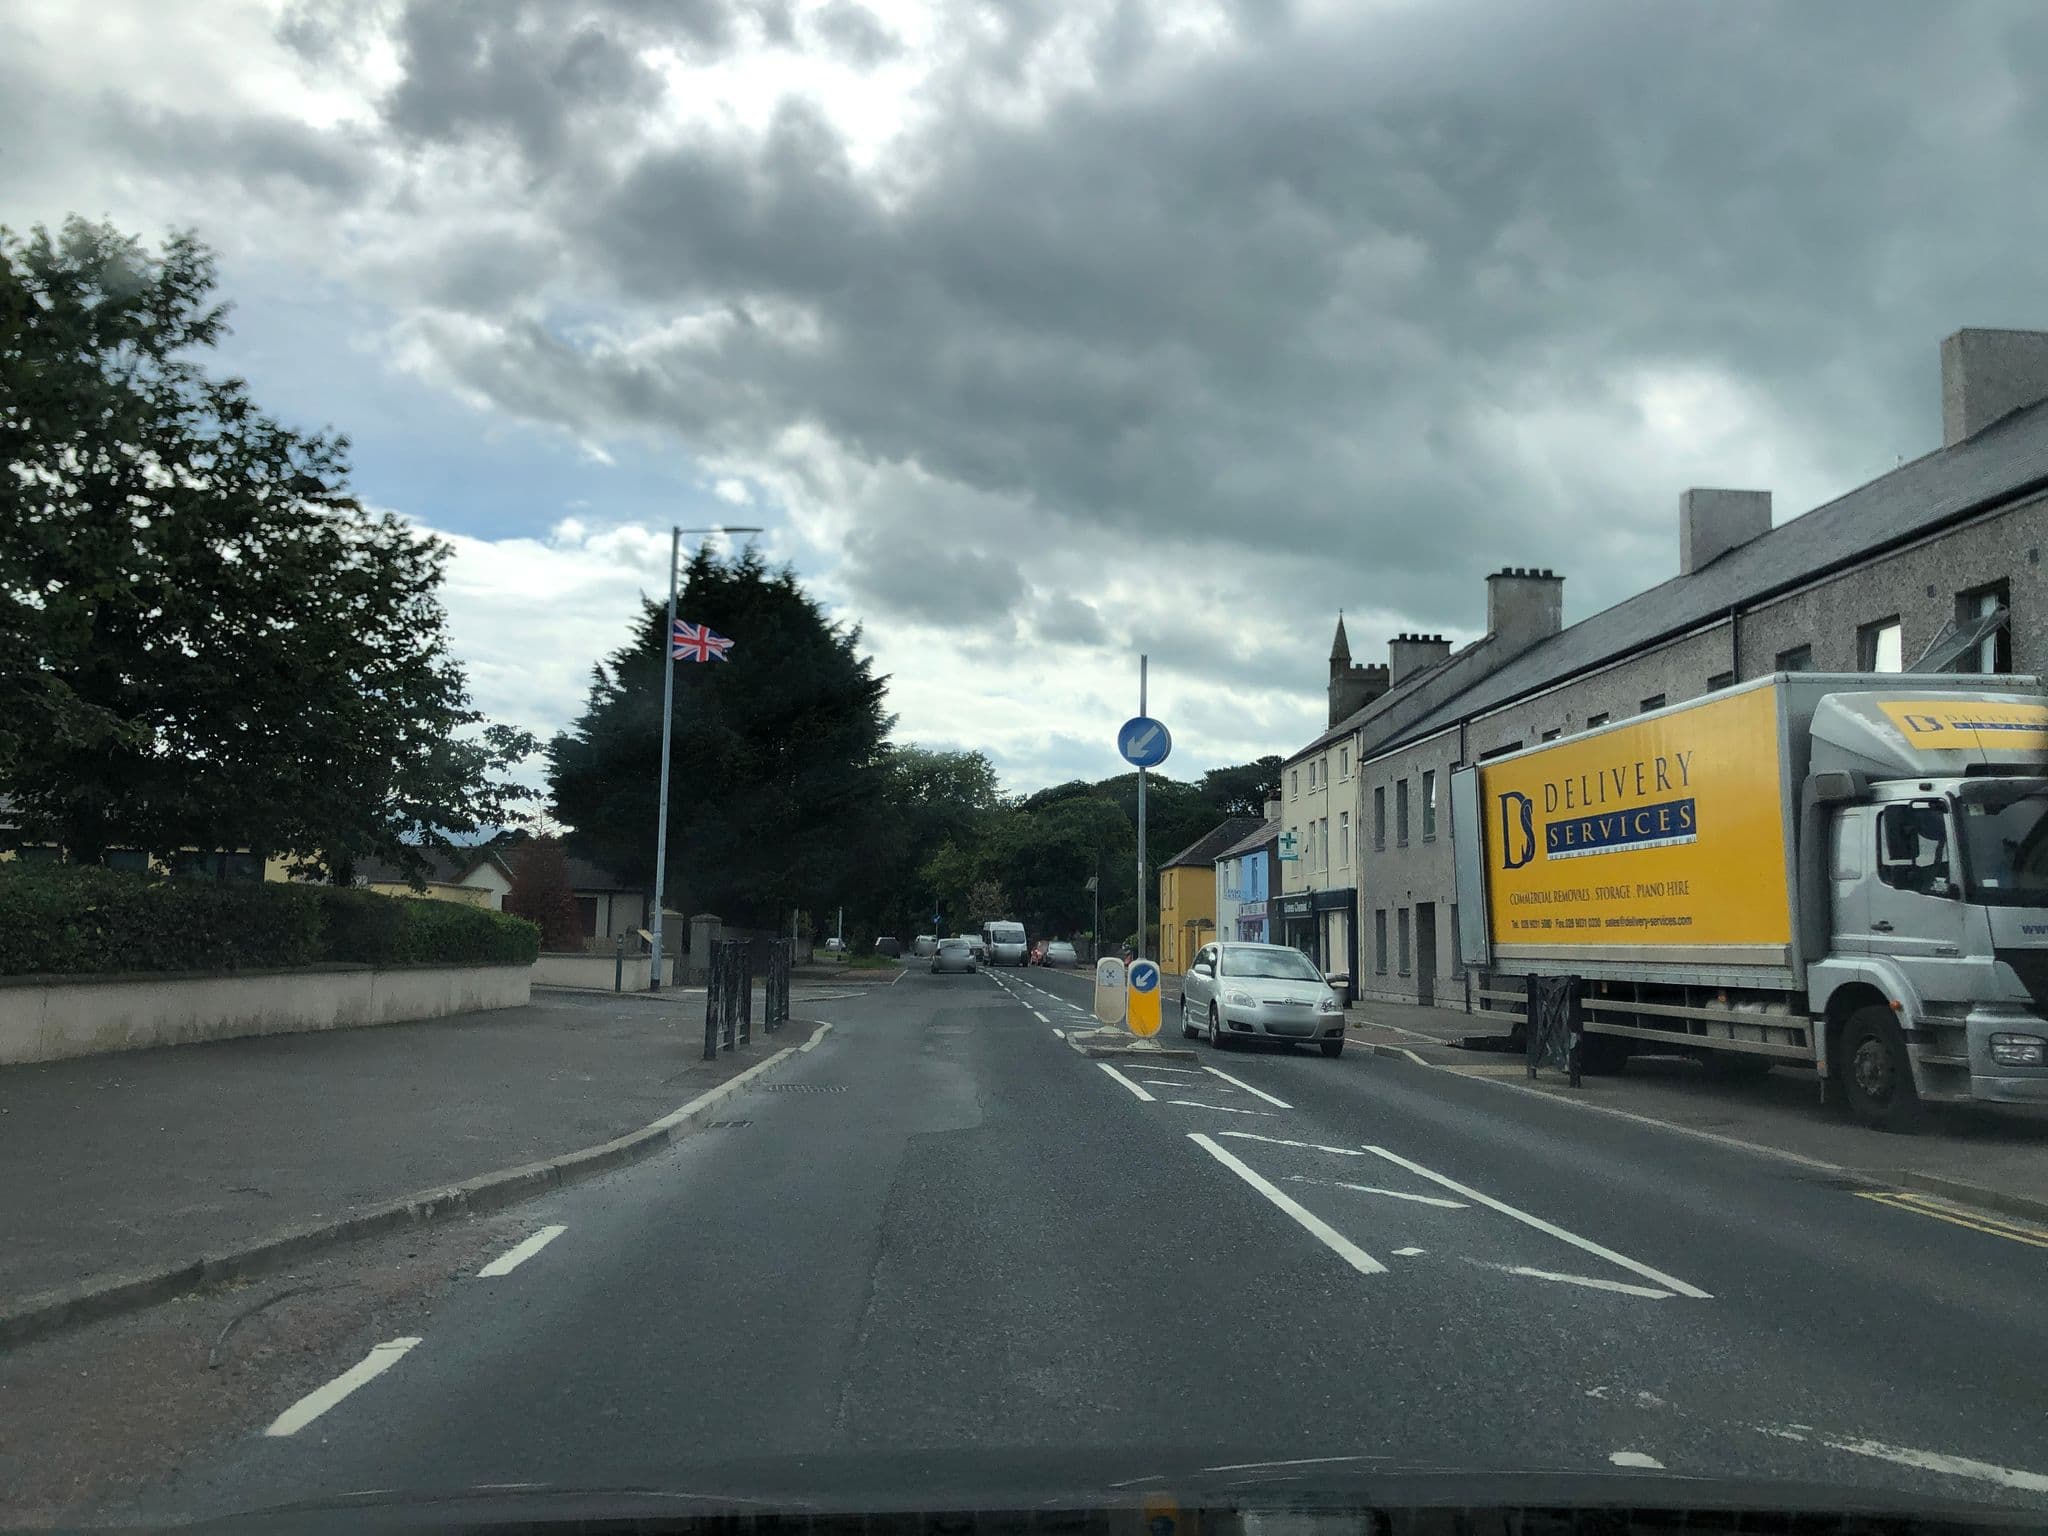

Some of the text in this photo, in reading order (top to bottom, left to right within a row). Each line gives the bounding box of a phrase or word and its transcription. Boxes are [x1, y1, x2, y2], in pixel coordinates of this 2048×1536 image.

[1544, 751, 1693, 813] DELIVERY
[1498, 791, 1536, 869] DS
[1550, 805, 1691, 847] SERVICES
[1509, 880, 1689, 905] COMMERCIAL REMOVALS STORAGE PIANO HIRE
